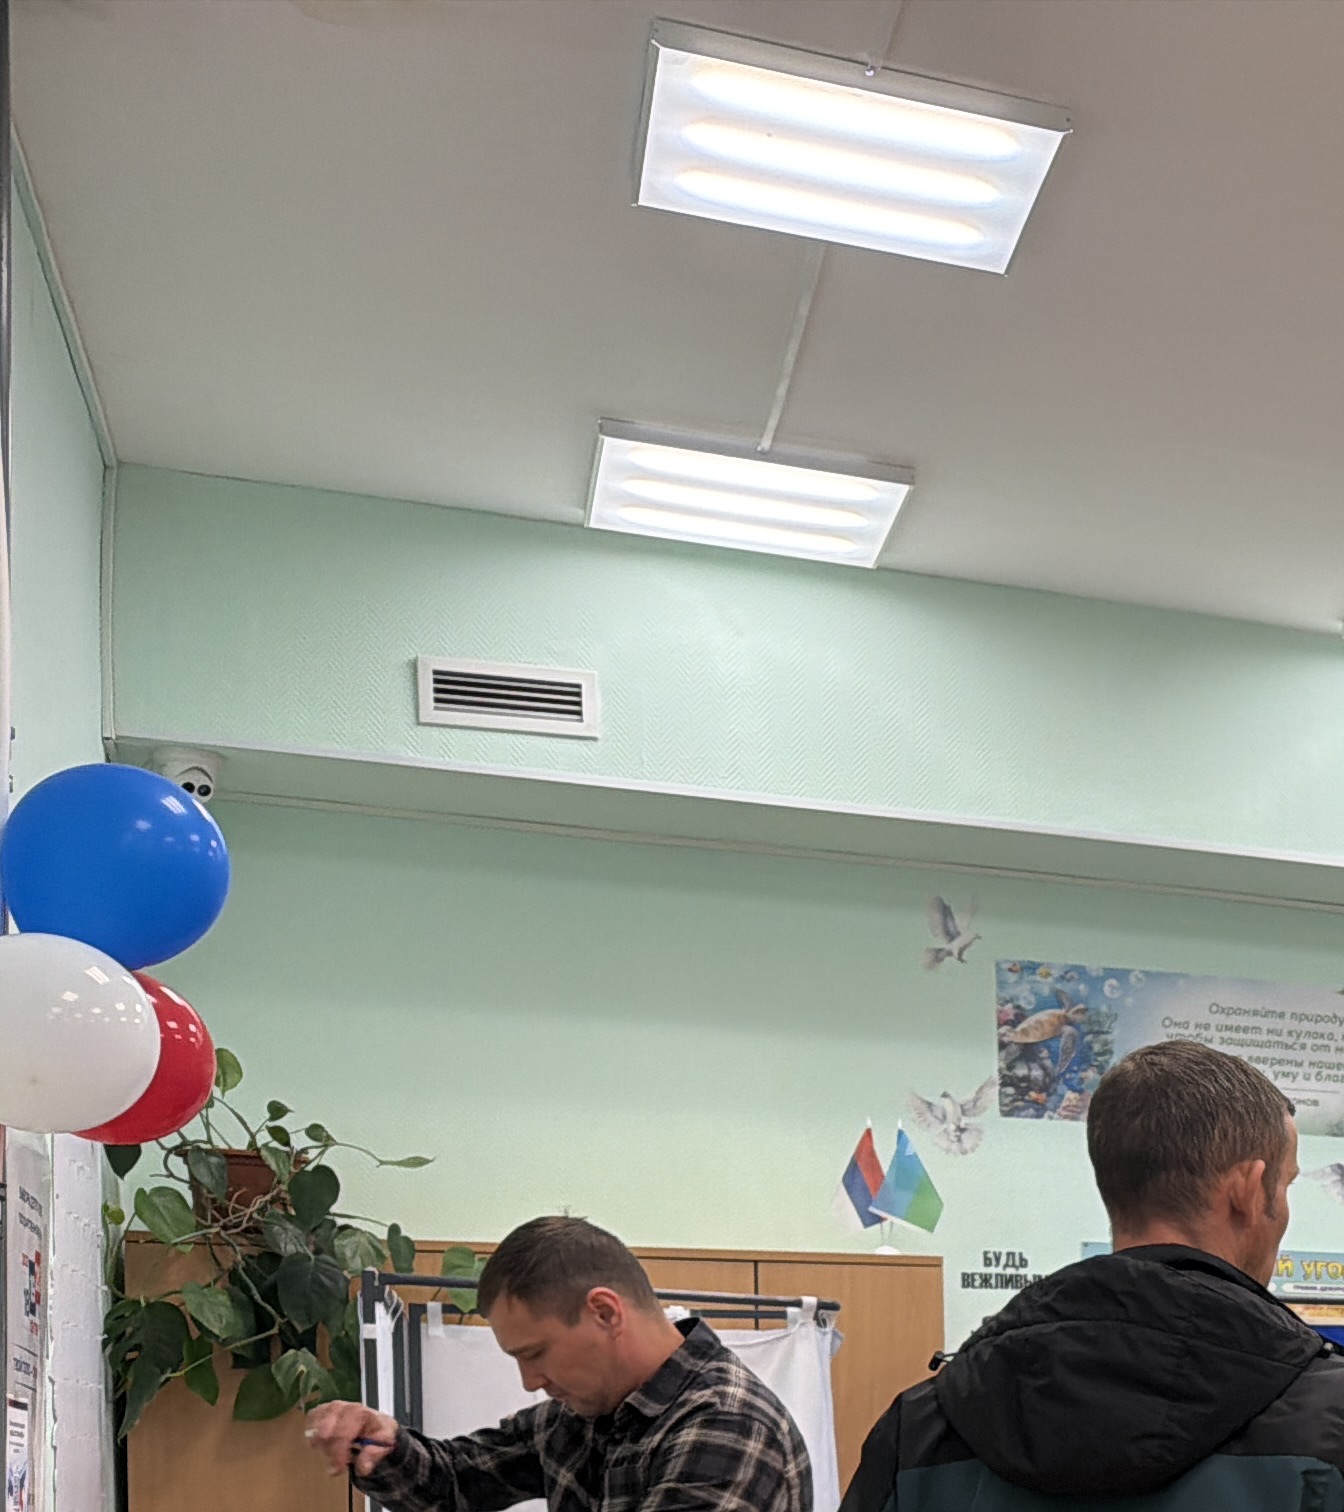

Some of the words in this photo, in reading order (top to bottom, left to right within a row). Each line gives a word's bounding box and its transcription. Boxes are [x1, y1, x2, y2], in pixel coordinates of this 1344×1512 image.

[1208, 1002, 1286, 1019] Охраняйте
[1161, 1016, 1190, 1030] Она
[1194, 1022, 1211, 1032] не
[1215, 1023, 1262, 1035] имеет
[1266, 1027, 1283, 1037] ни
[1219, 1036, 1307, 1052] защищаться
[1310, 1043, 1331, 1053] от
[1273, 1069, 1300, 1083] уму
[1303, 1072, 1311, 1081] и
[983, 1250, 1029, 1271] БУДЬ
[961, 1272, 1049, 1290] ВЕЖЛИВЫ
